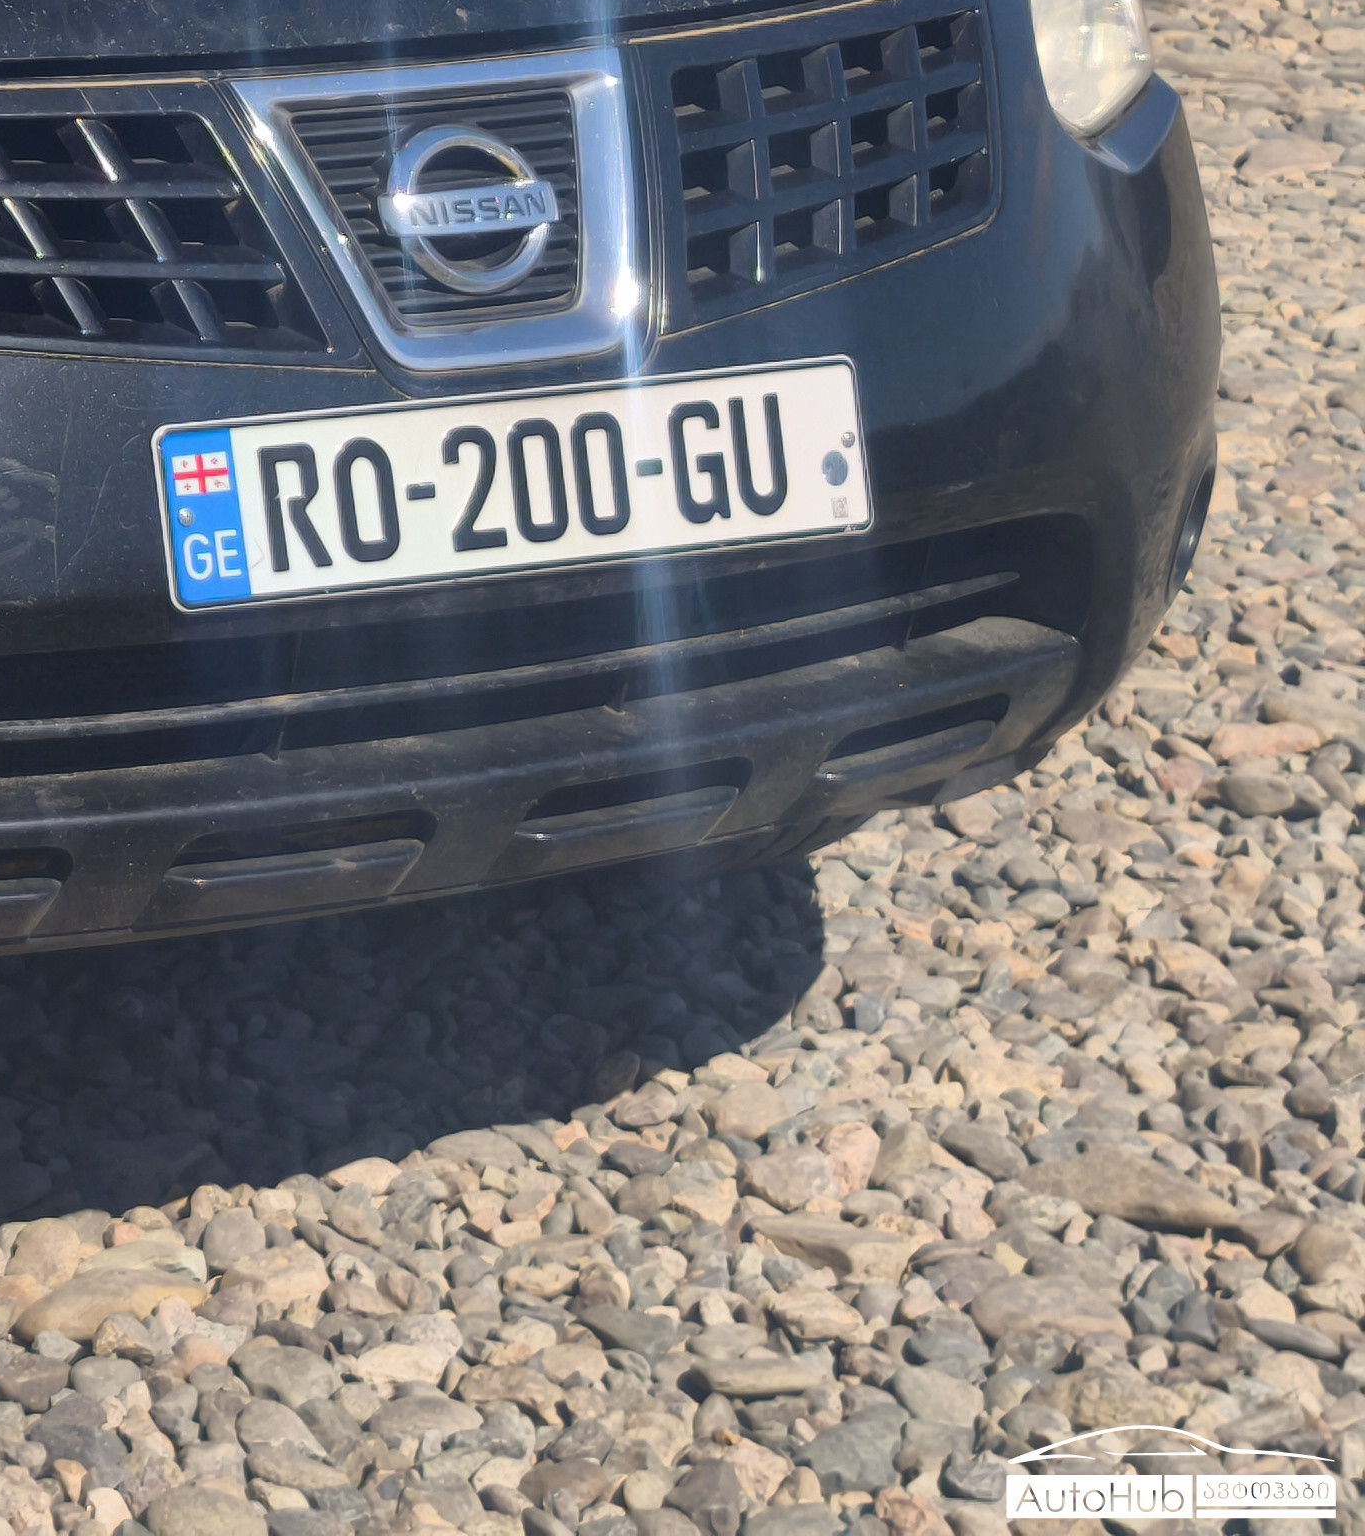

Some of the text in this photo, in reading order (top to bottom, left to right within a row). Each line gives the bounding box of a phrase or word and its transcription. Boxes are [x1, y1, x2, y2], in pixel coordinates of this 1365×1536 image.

[410, 191, 547, 226] NISSAN
[257, 393, 788, 572] RO-200-GU
[184, 529, 242, 580] GE
